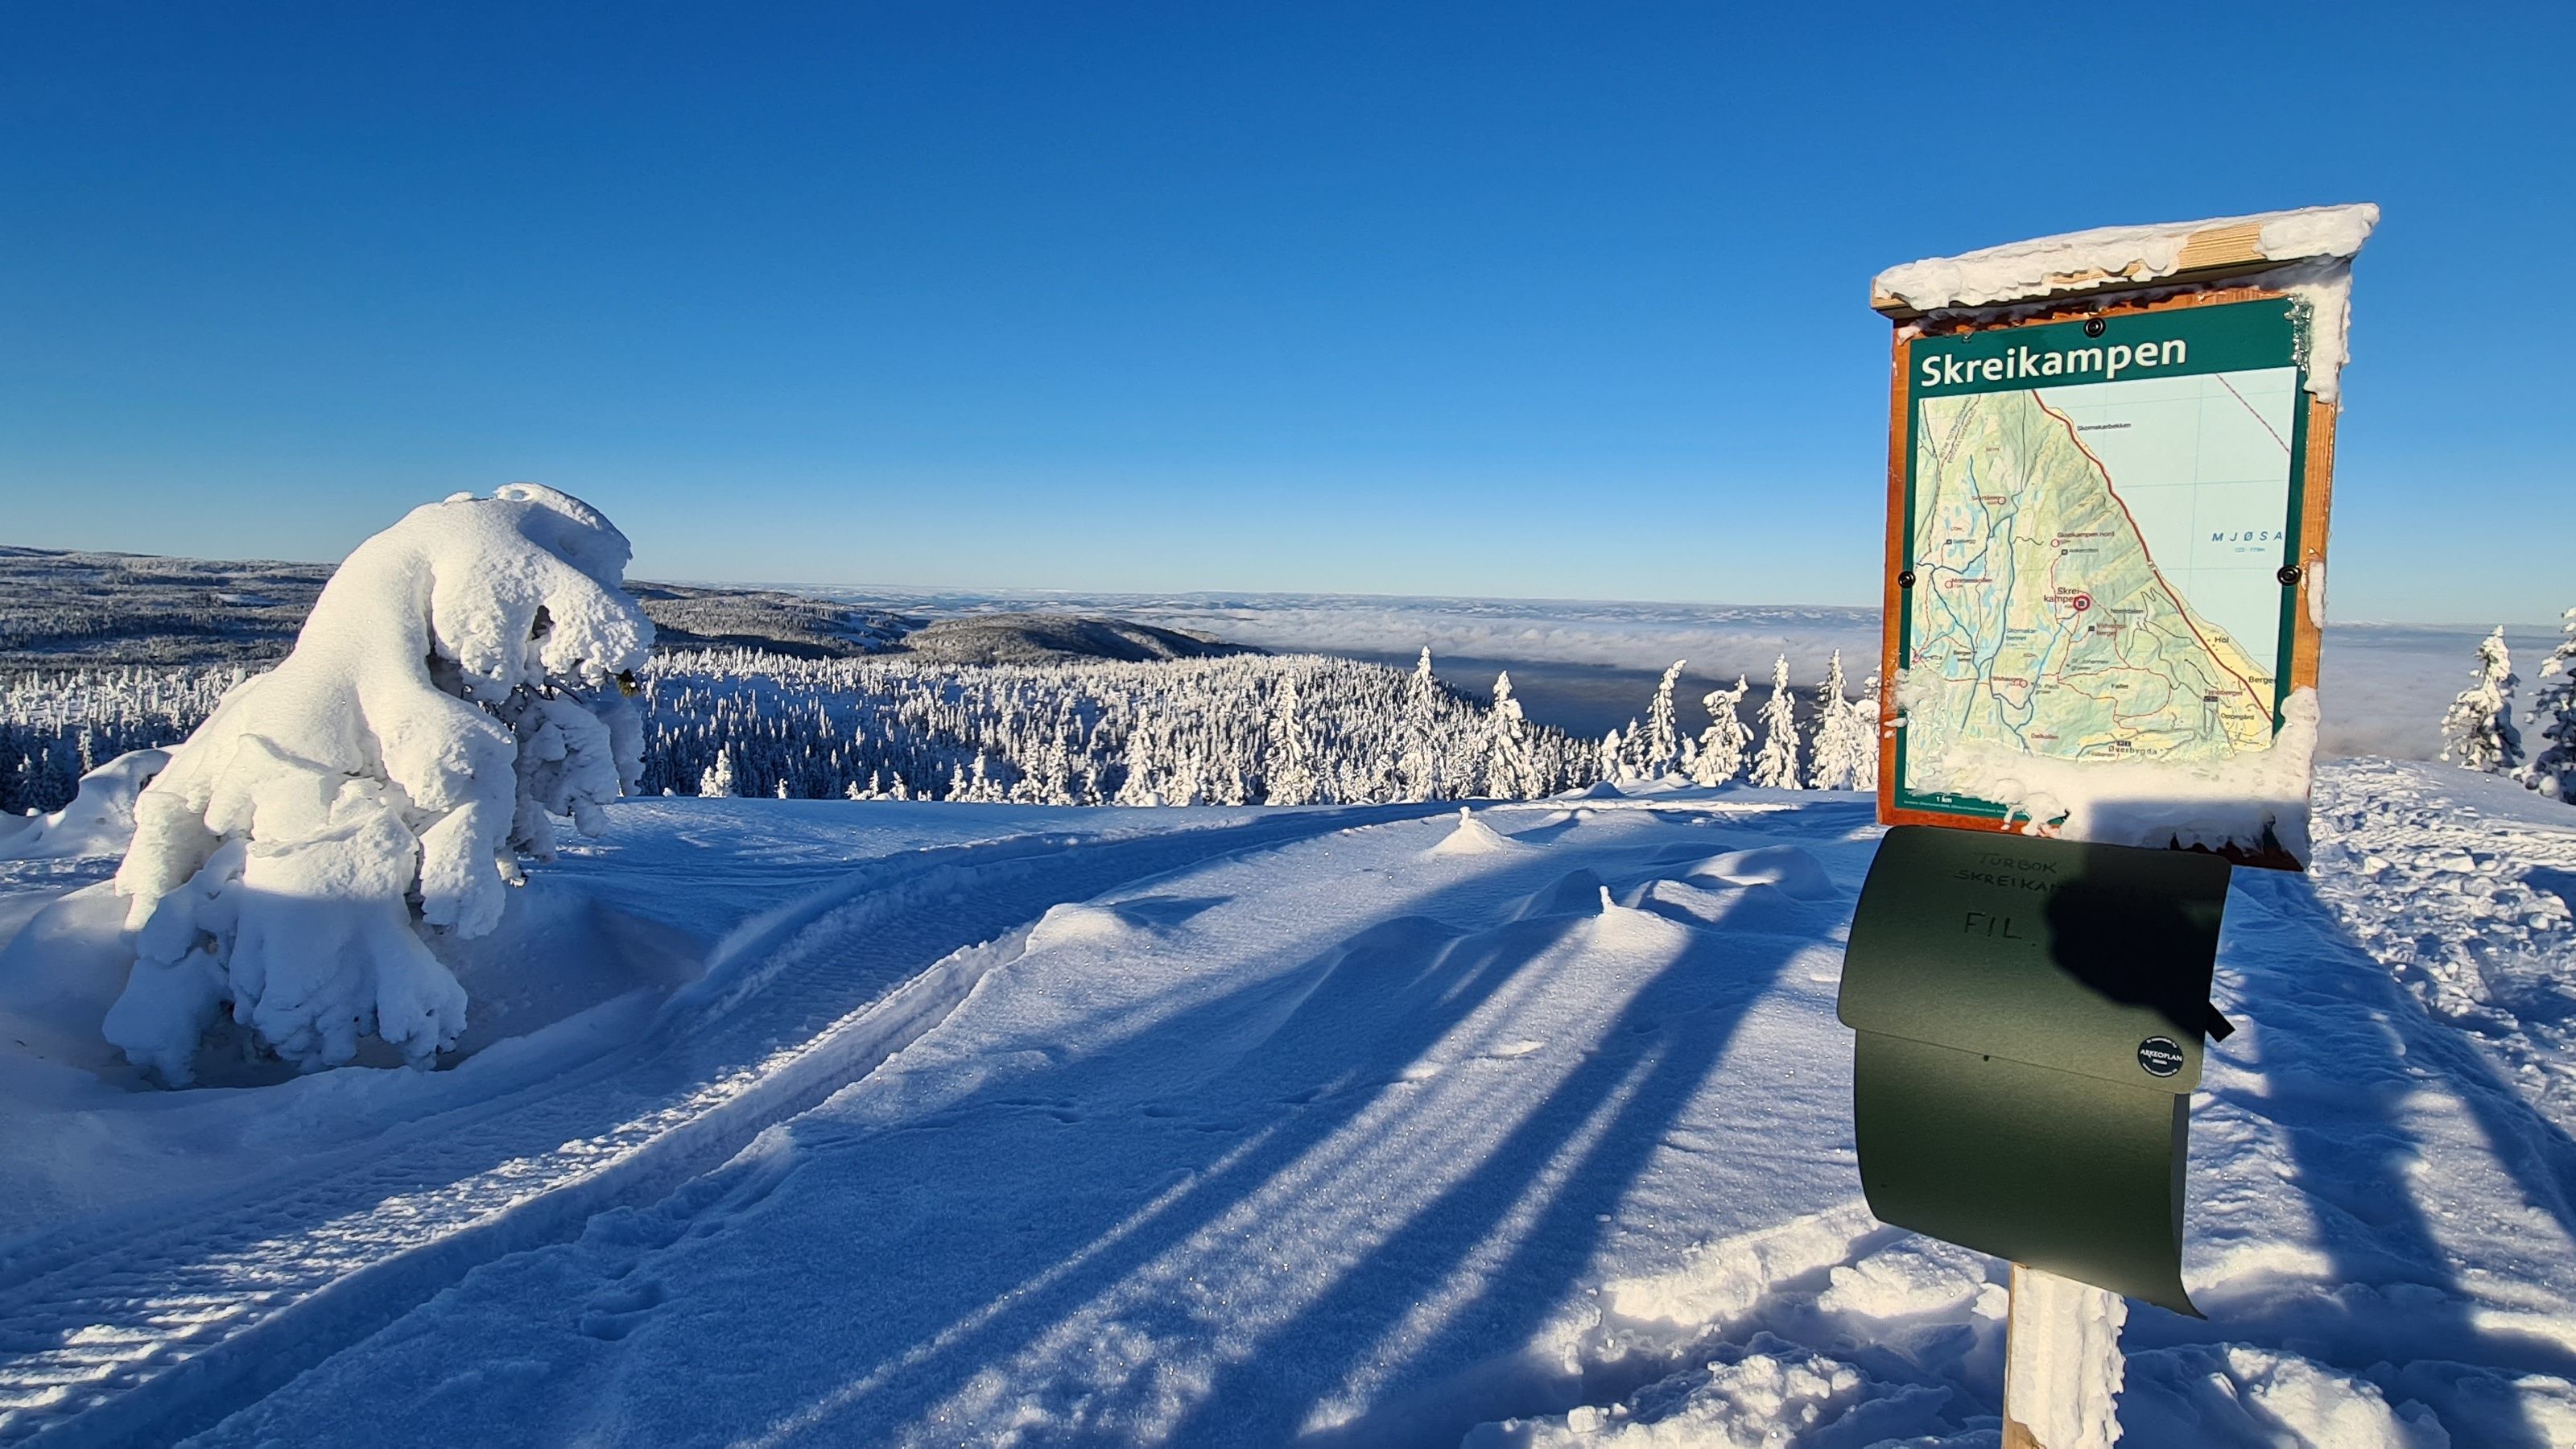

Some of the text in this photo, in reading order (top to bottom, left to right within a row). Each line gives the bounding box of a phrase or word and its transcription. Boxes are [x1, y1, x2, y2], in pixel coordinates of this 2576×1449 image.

[1921, 338, 2186, 387] Skreikampen
[2211, 531, 2283, 542] MJØSA
[2044, 595, 2075, 604] kampe
[2108, 745, 2157, 756] Øverbygda
